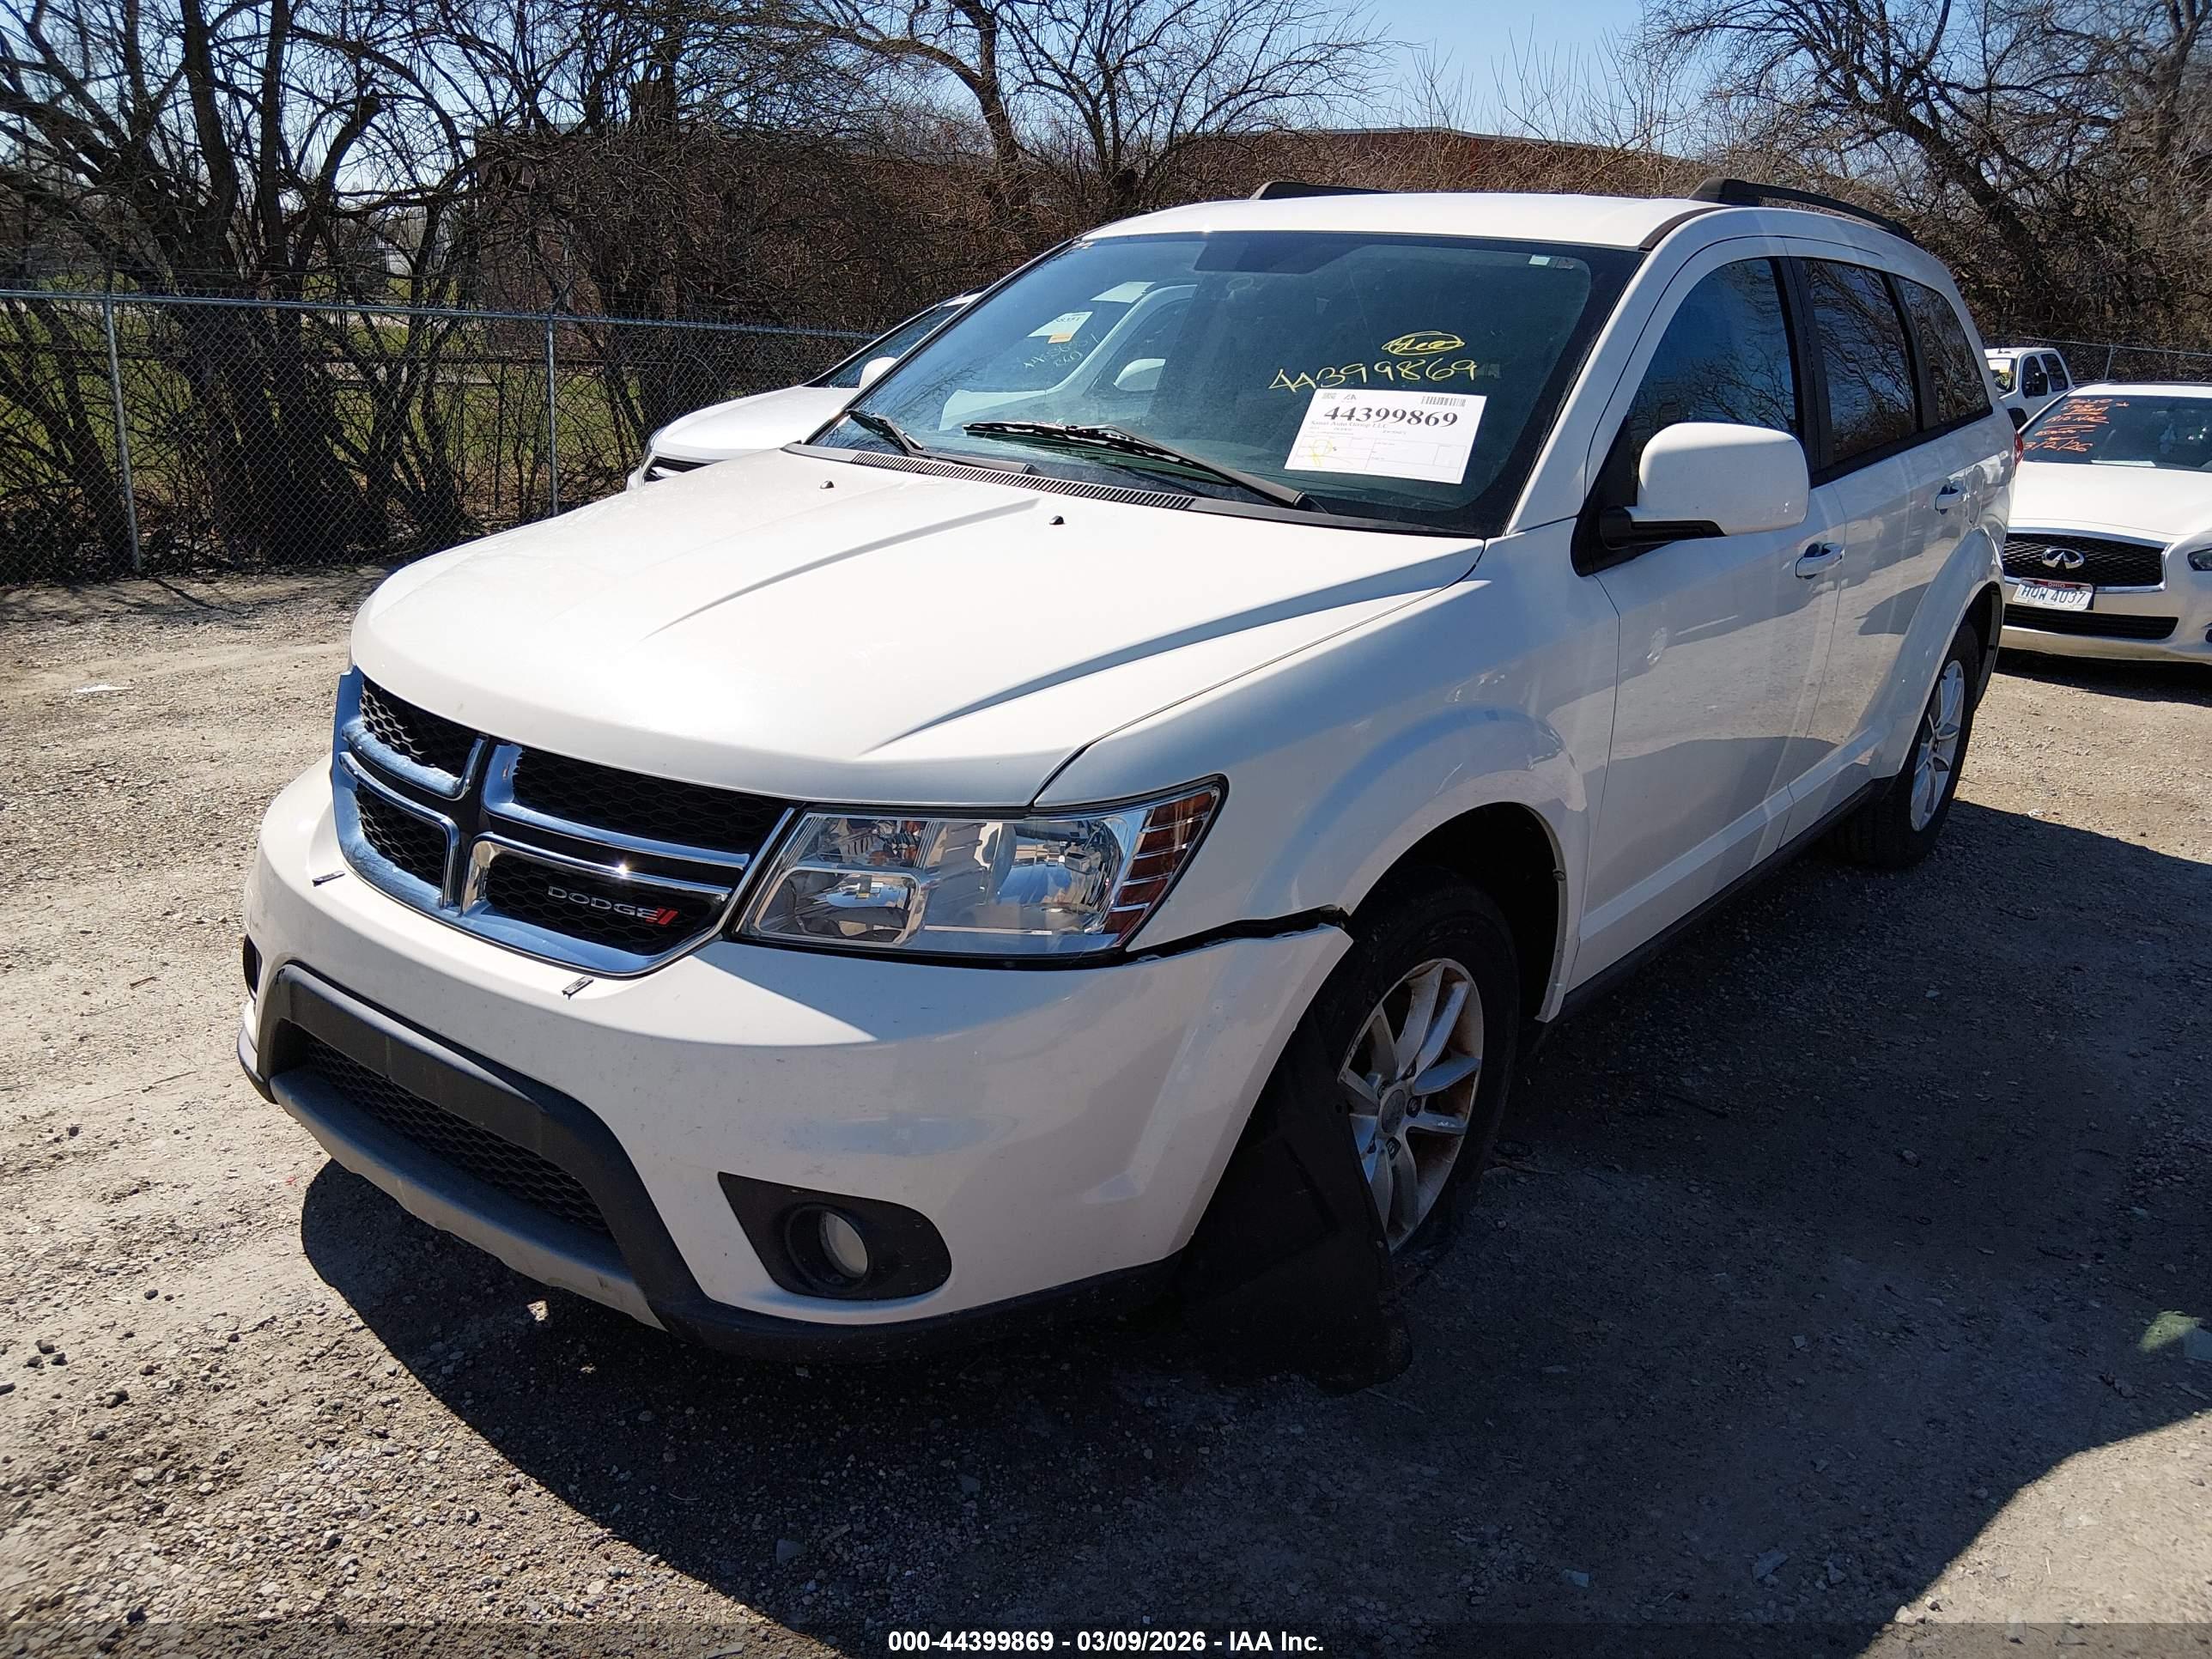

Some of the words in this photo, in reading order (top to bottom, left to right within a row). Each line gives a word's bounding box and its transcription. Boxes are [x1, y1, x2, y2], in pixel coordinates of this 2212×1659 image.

[1324, 406, 1458, 428] 44399869
[2051, 589, 2087, 604] 4037
[547, 885, 659, 921] DODGE
